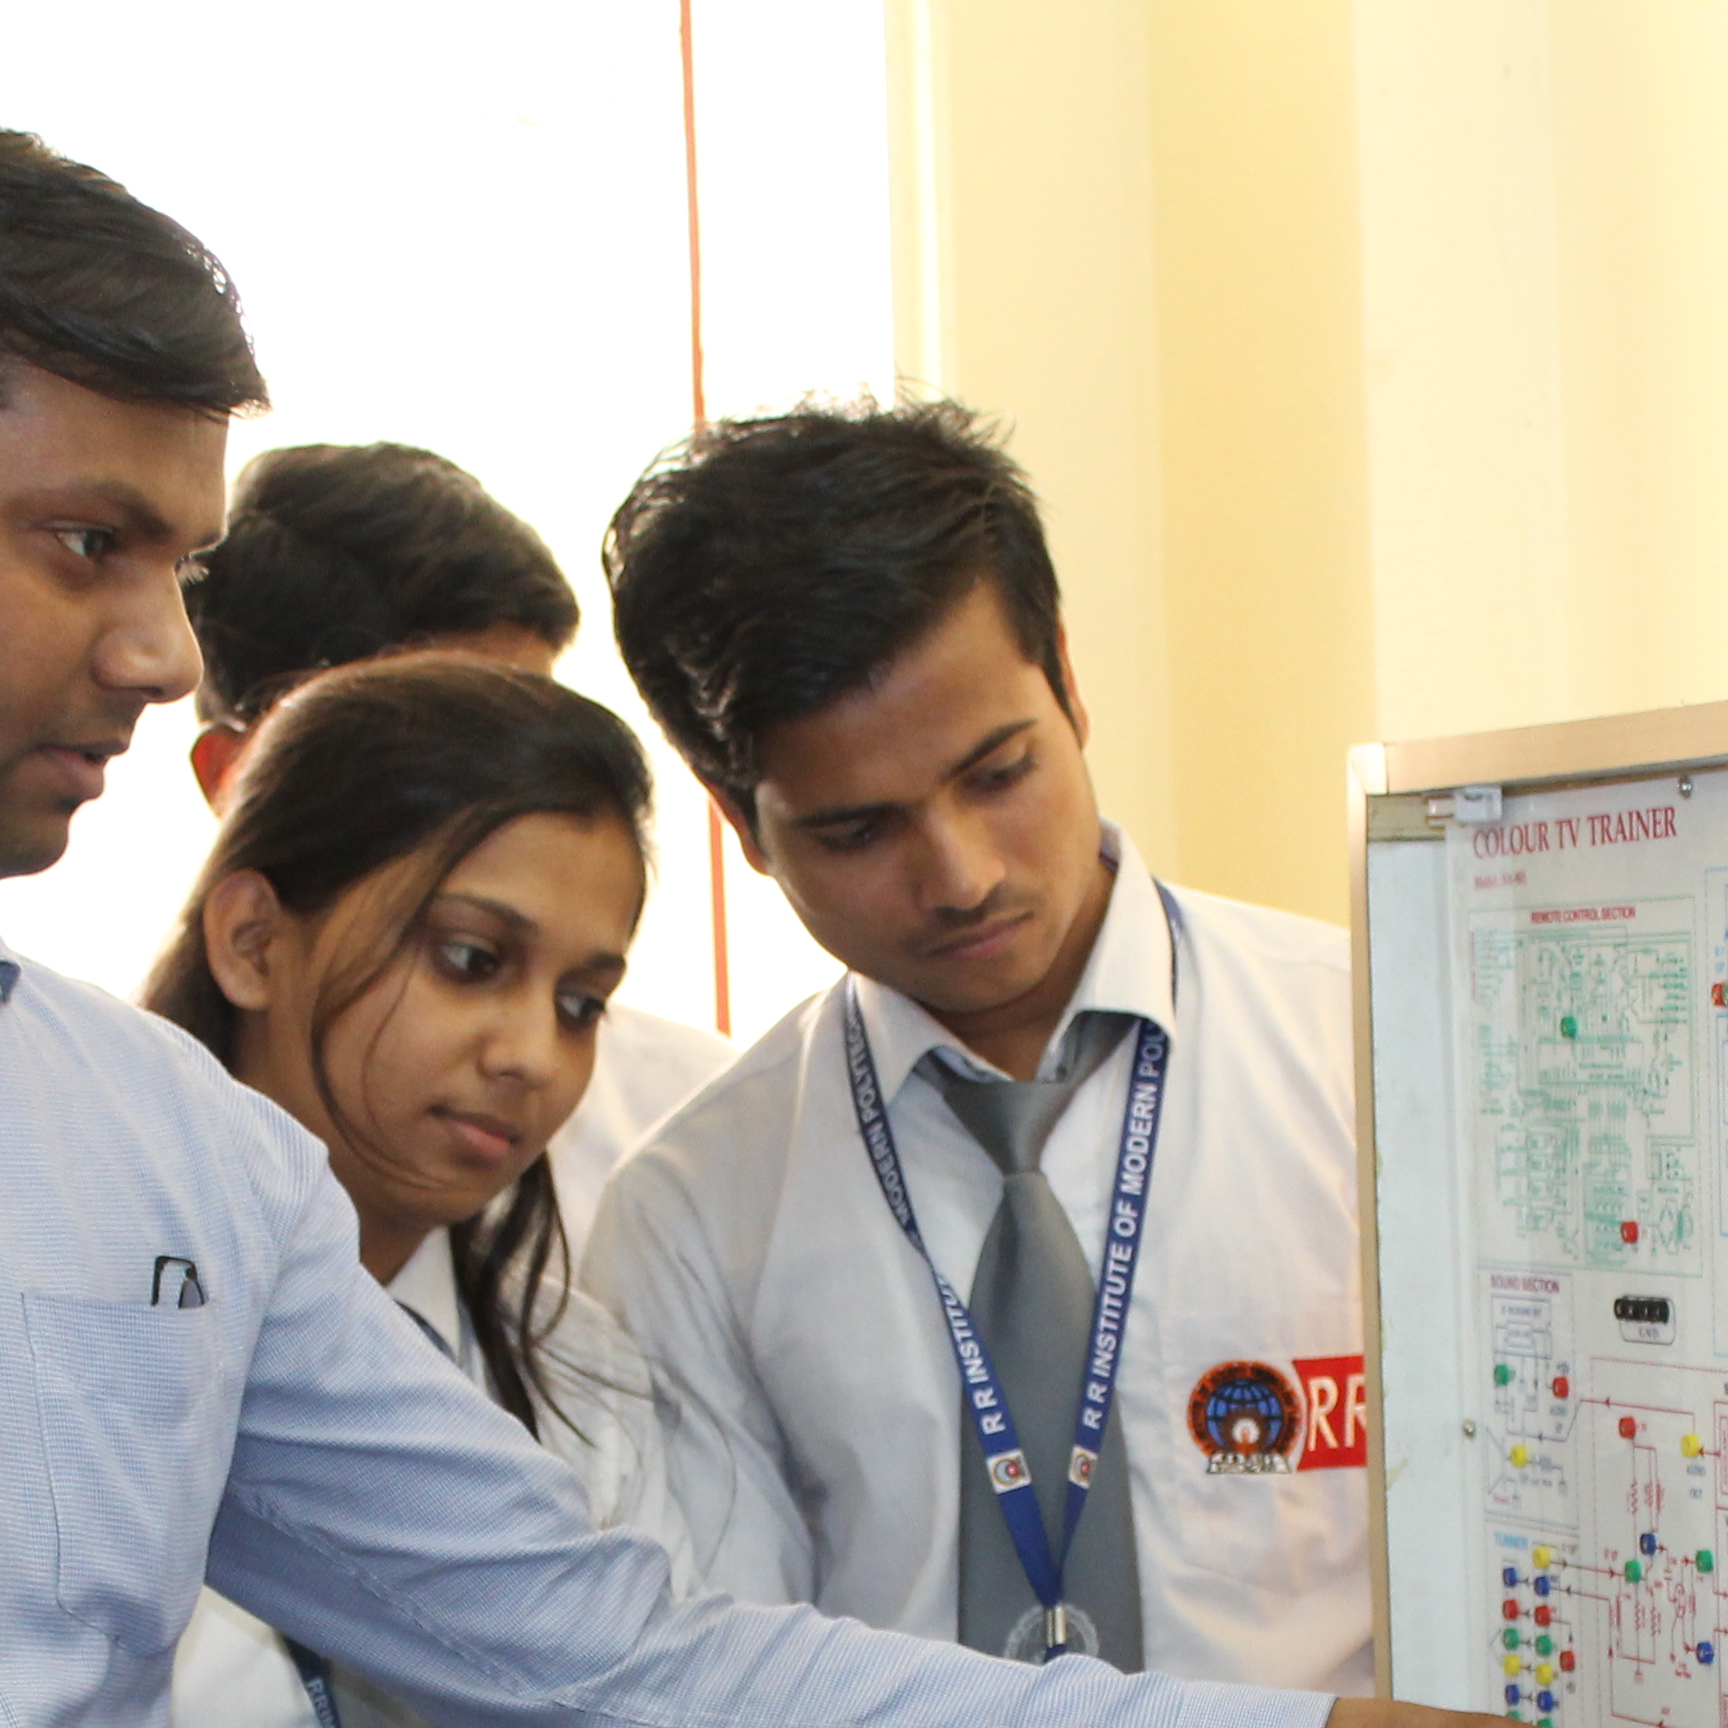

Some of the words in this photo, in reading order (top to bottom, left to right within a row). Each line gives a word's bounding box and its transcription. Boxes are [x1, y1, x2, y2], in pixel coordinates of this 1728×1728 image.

[1474, 821, 1550, 859] COLOUR
[1555, 818, 1581, 849] TV
[1587, 806, 1678, 847] TRAINER
[1119, 1080, 1160, 1196] MODERN
[1113, 1198, 1140, 1239] OF
[1092, 1242, 1133, 1378] INSTITUTE
[973, 1386, 998, 1409] R
[1087, 1380, 1108, 1404] R
[981, 1411, 1007, 1435] R
[1082, 1406, 1103, 1430] R
